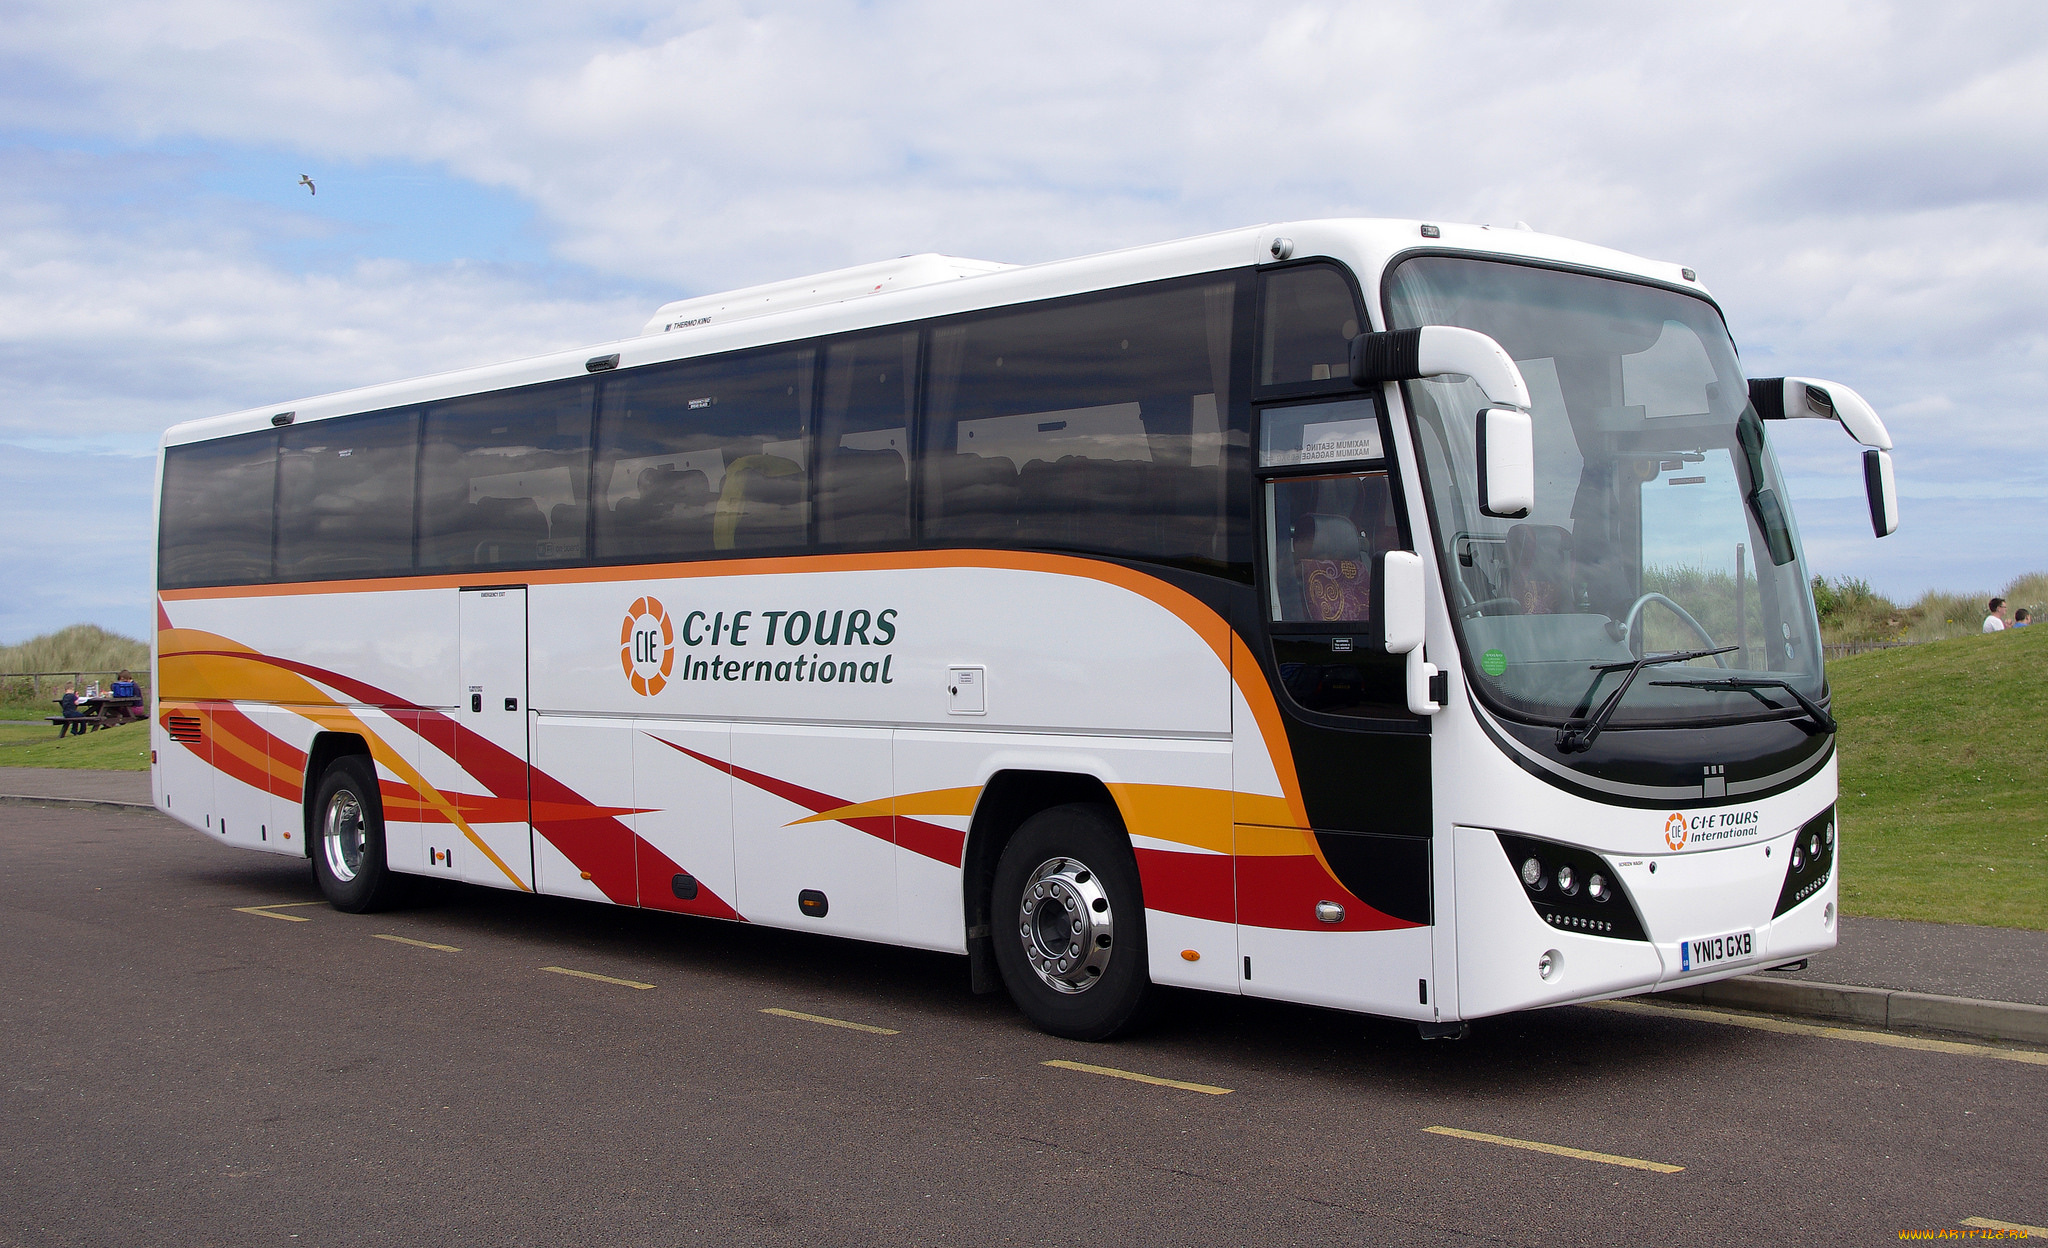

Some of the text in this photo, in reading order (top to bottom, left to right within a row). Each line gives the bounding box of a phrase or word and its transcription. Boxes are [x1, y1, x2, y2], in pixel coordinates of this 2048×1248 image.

[673, 316, 712, 330] THERMO KING
[762, 607, 899, 647] TOURS
[635, 630, 658, 665] CIE
[682, 653, 894, 685] International
[1719, 810, 1759, 827] TOURS
[1671, 824, 1681, 839] CIE
[1690, 825, 1758, 843] International
[1693, 933, 1751, 964] YN13 GXB
